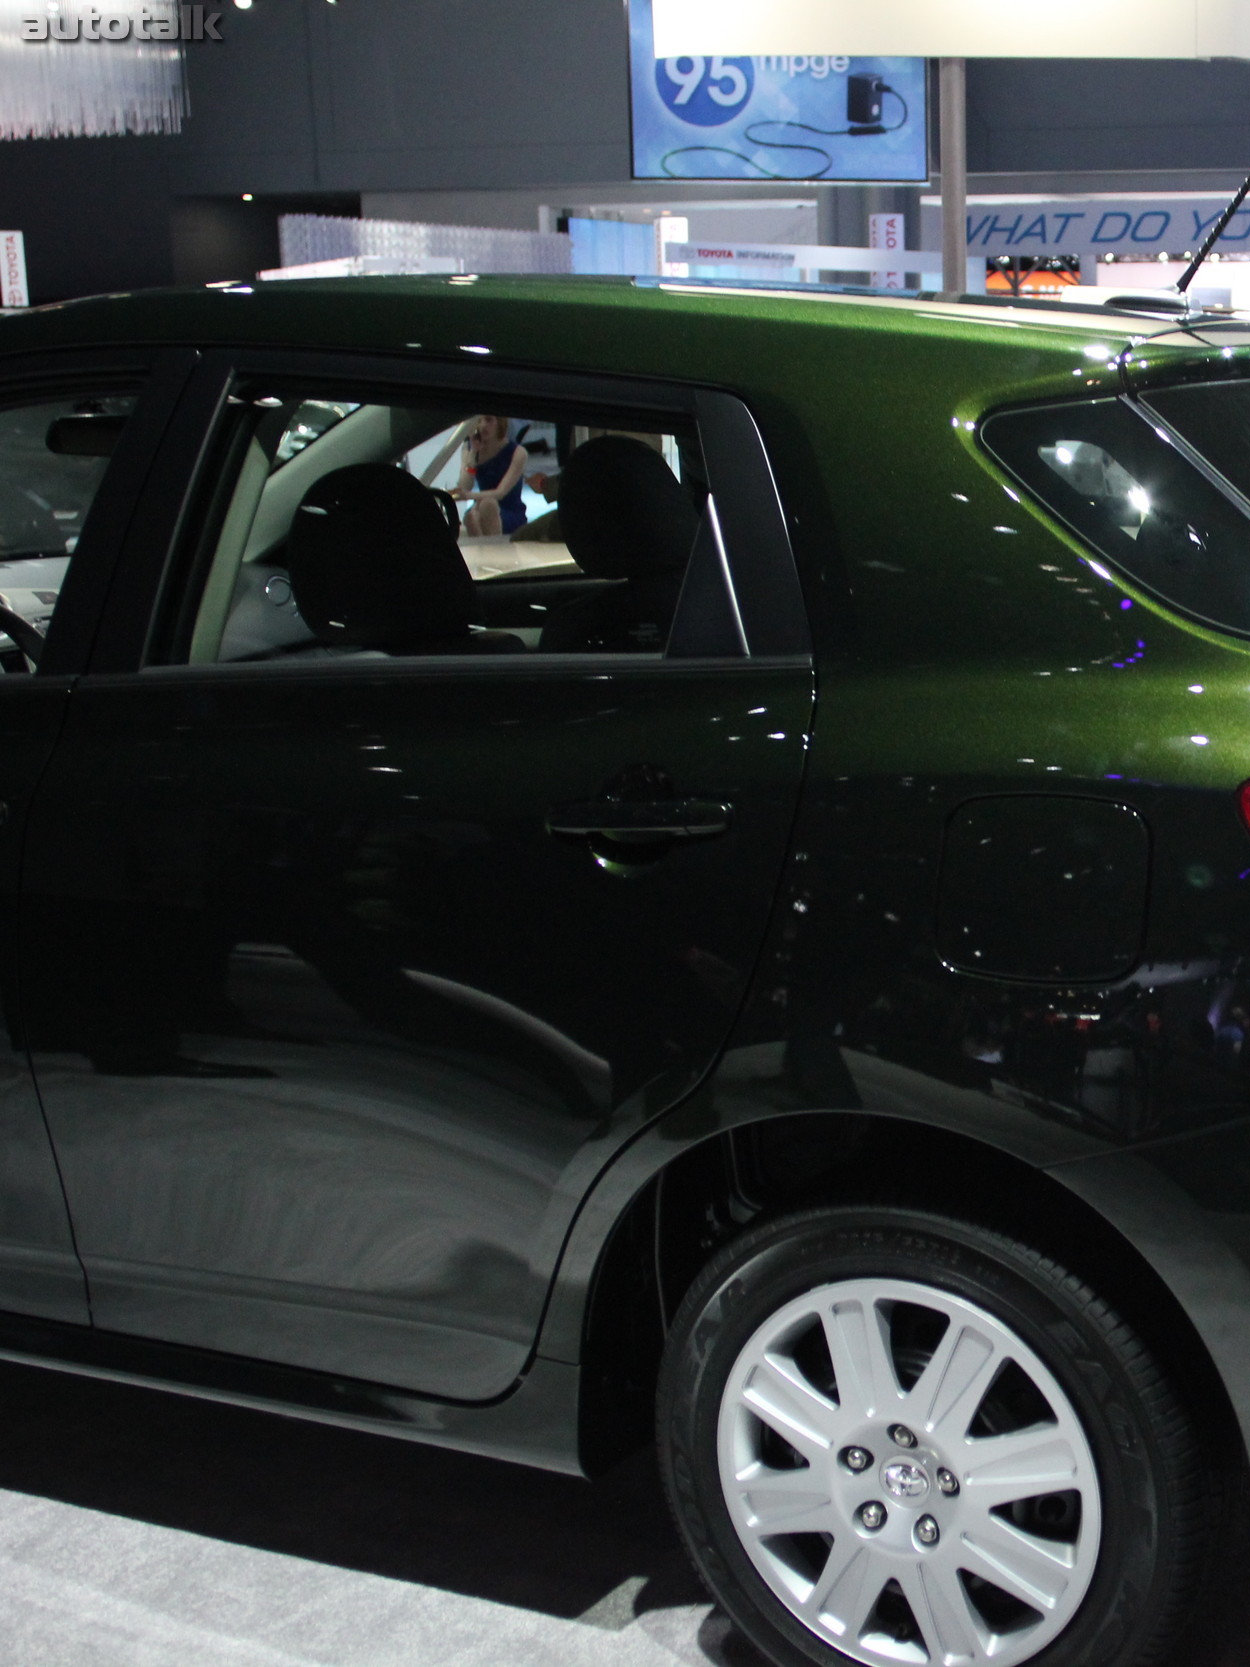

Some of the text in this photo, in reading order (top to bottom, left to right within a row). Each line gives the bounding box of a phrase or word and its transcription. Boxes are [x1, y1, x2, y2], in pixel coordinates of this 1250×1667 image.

[664, 56, 849, 107] 95 mpge
[1091, 211, 1171, 243] DO
[6, 236, 19, 286] TOYOTA
[697, 247, 734, 258] TOYOTA
